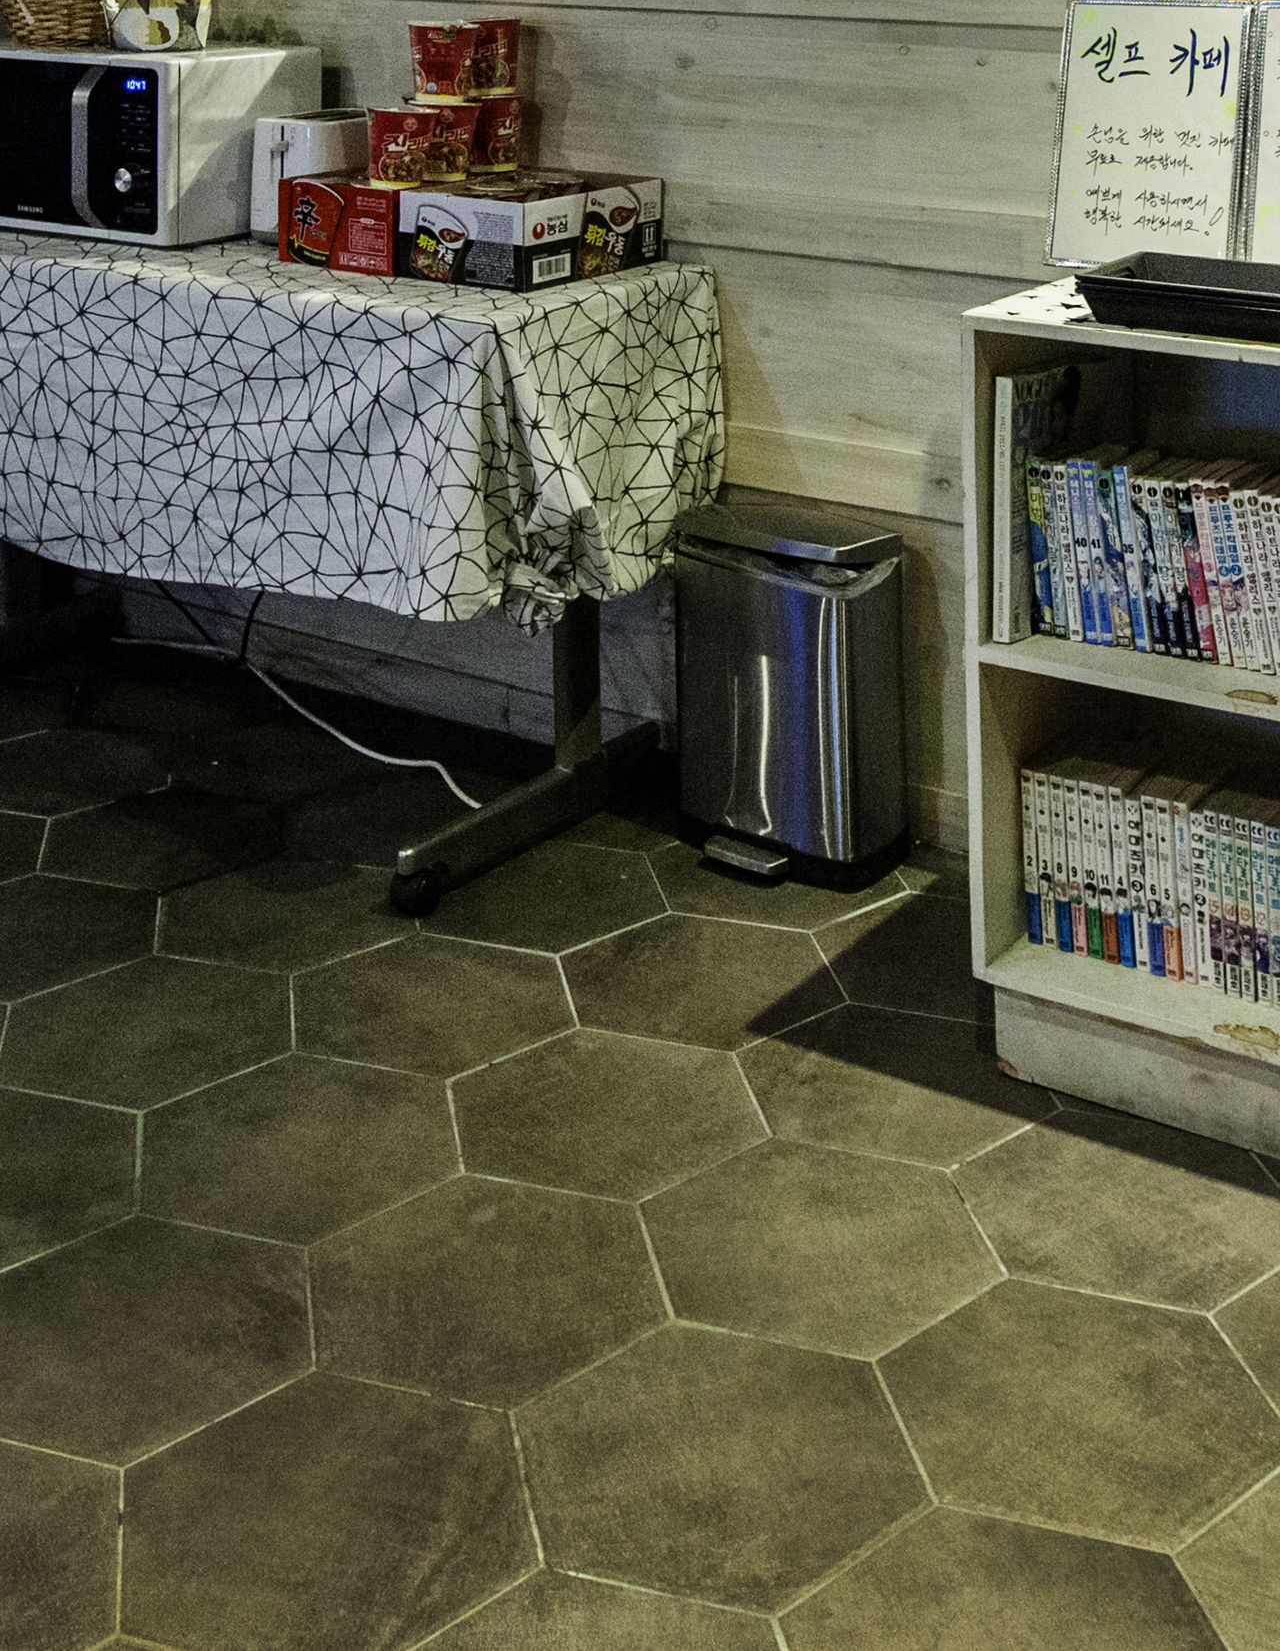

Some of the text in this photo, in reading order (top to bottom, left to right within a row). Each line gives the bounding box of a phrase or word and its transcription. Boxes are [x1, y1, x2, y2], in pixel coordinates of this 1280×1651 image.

[1080, 26, 1231, 98] 셀프 카페
[1086, 124, 1130, 147] 손님을
[1139, 125, 1165, 149] 위한
[1174, 130, 1202, 148] 멋진
[293, 197, 321, 242] 辛
[546, 220, 569, 236] 농심
[1027, 855, 1033, 867] 2
[1042, 859, 1049, 871] 3
[1071, 866, 1078, 878] 9
[1084, 869, 1095, 881] 10
[1150, 883, 1157, 896] 6
[1164, 888, 1171, 900] 5
